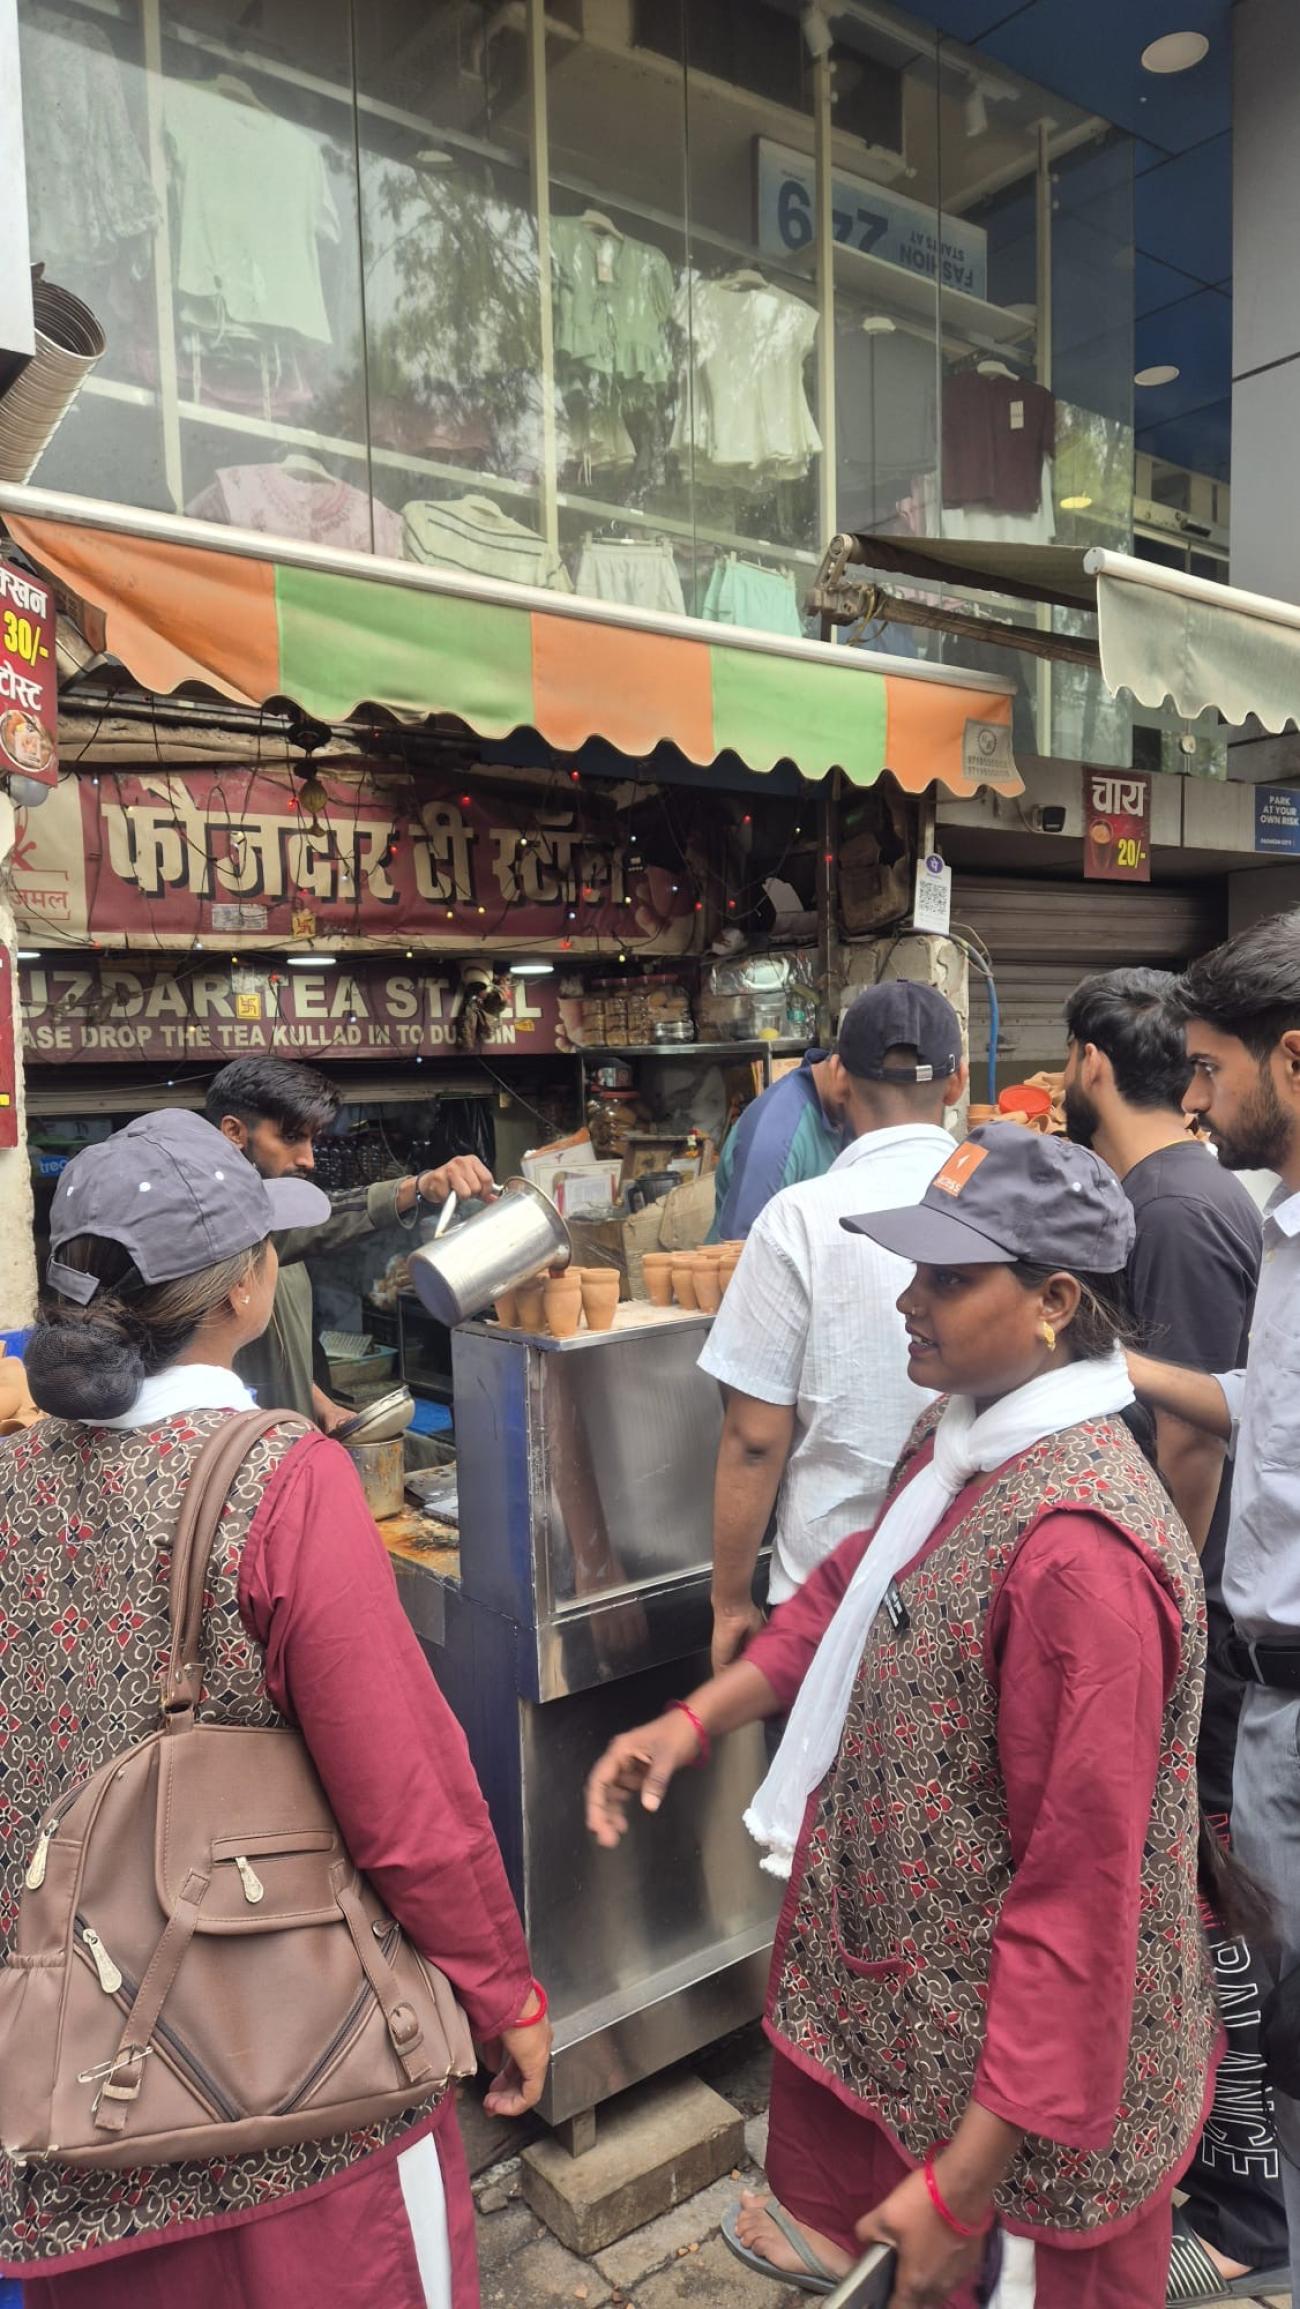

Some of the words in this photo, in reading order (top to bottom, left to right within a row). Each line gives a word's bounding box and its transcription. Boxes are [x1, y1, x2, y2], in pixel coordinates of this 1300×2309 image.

[4, 610, 49, 667] 30/-
[1091, 776, 1147, 817] चाय
[409, 801, 473, 901] टी
[1117, 838, 1146, 869] 20/-
[254, 975, 369, 1018] TEA
[385, 976, 542, 1018] STL
[81, 1025, 152, 1049] DROP
[160, 1025, 210, 1048] THE
[217, 1025, 266, 1047] TEA
[273, 1024, 362, 1047] KULLAD
[368, 1024, 390, 1045] IN
[396, 1024, 424, 1045] TO
[430, 1024, 516, 1046] DUIN
